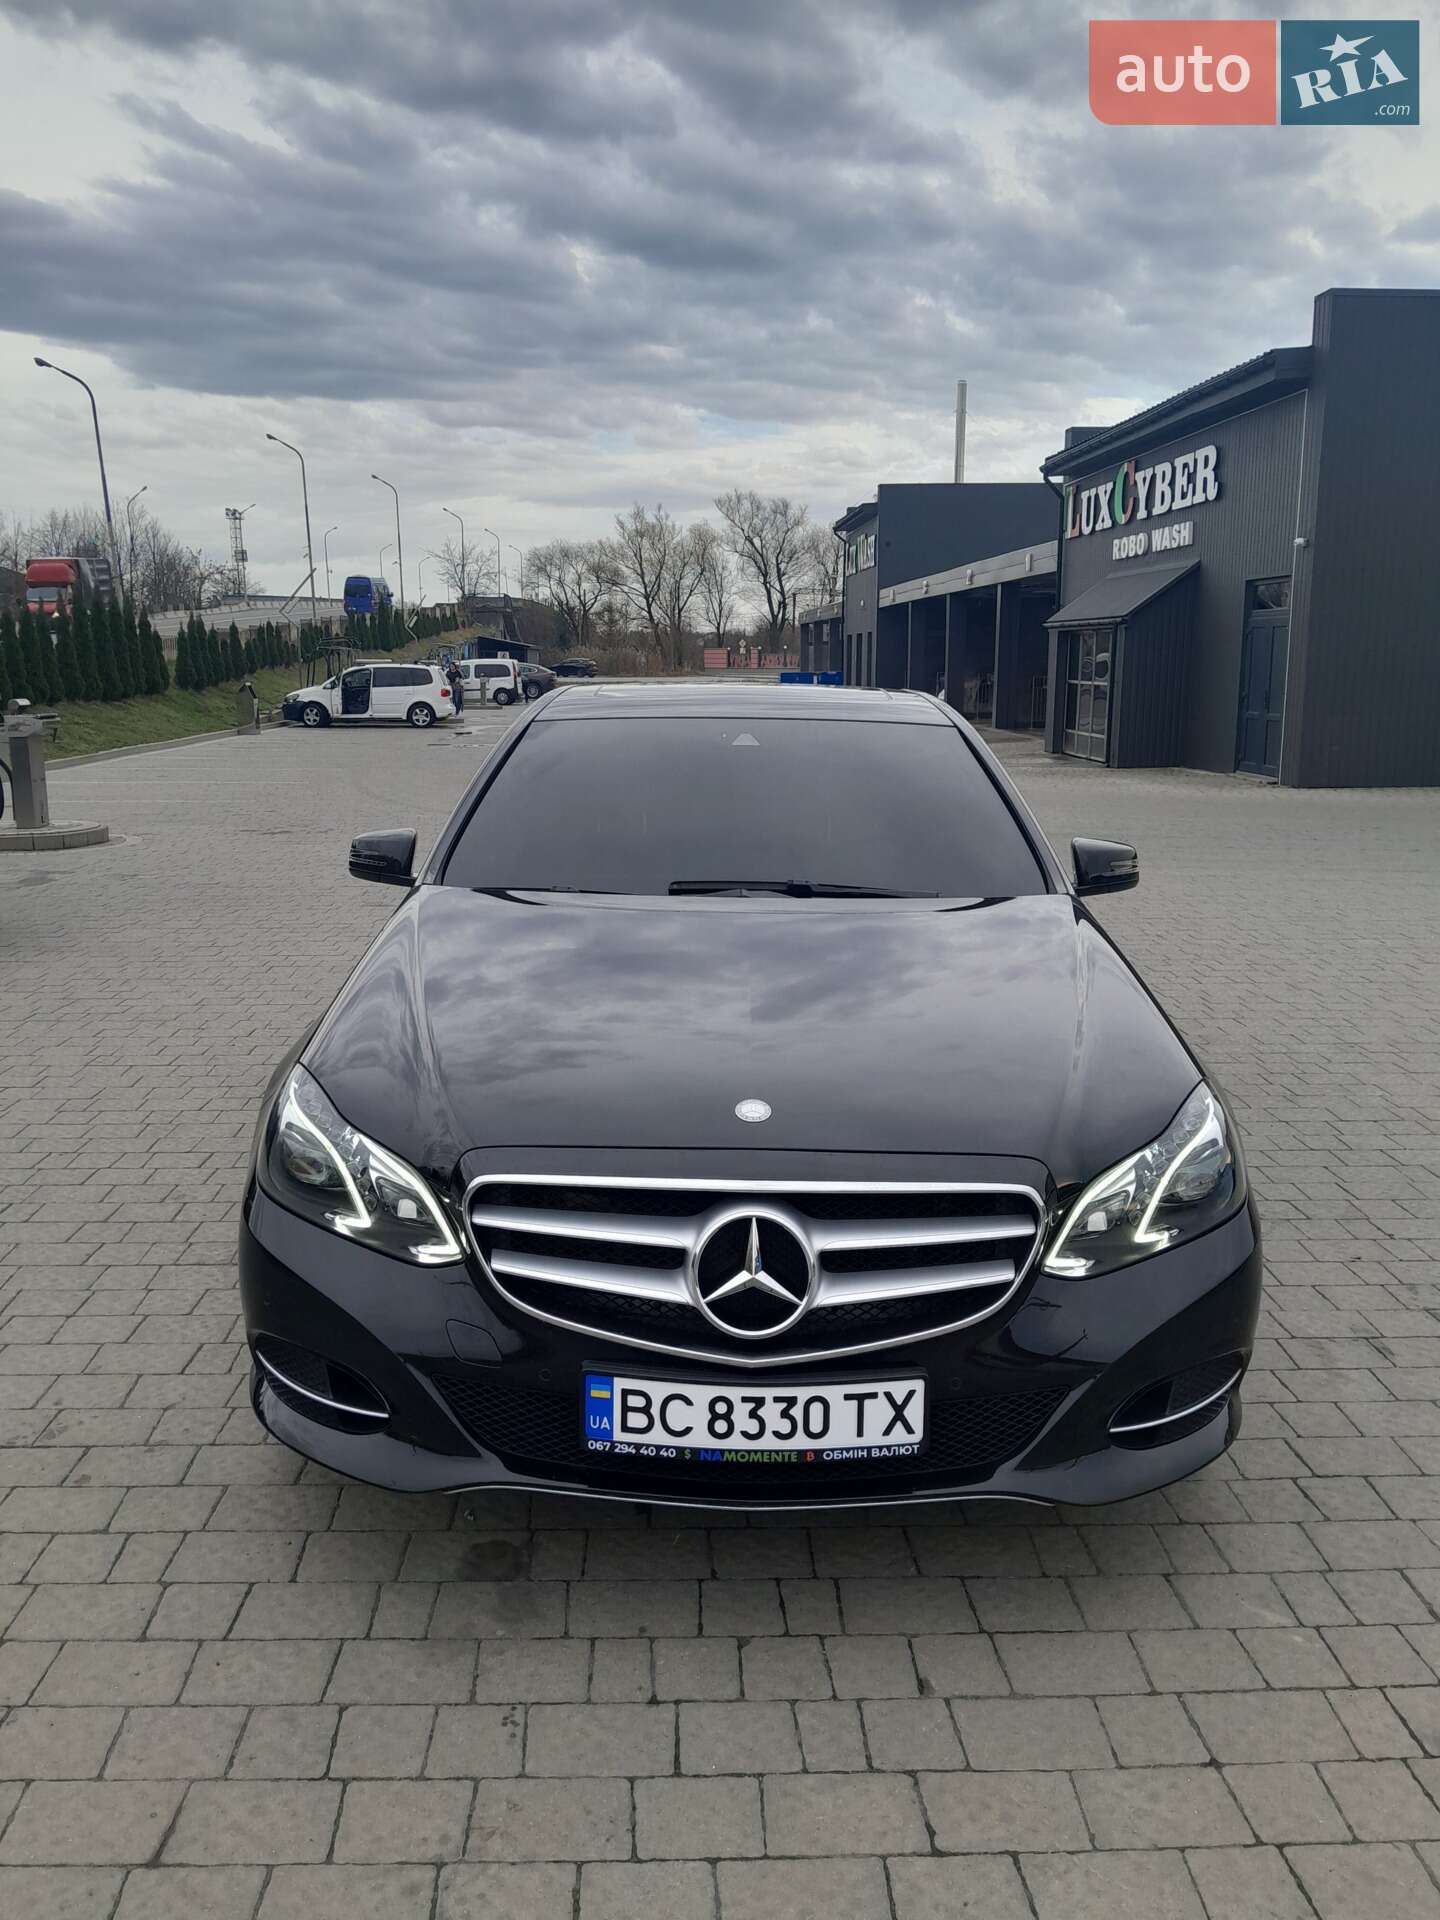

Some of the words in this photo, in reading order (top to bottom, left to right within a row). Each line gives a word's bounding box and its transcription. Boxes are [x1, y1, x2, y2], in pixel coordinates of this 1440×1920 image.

[1112, 532, 1149, 560] ROBO
[1151, 521, 1194, 552] WASH
[590, 1415, 611, 1431] UA
[621, 1388, 694, 1438] BC
[707, 1395, 830, 1441] 8330
[843, 1389, 917, 1438] TX
[588, 1440, 611, 1451] 067
[614, 1443, 636, 1454] 294
[640, 1446, 656, 1456] 40
[660, 1448, 676, 1458] 40
[700, 1449, 798, 1462] NAMOMENTE
[823, 1448, 867, 1460] ОБМІН
[871, 1445, 920, 1457] ВАЛЮТ
